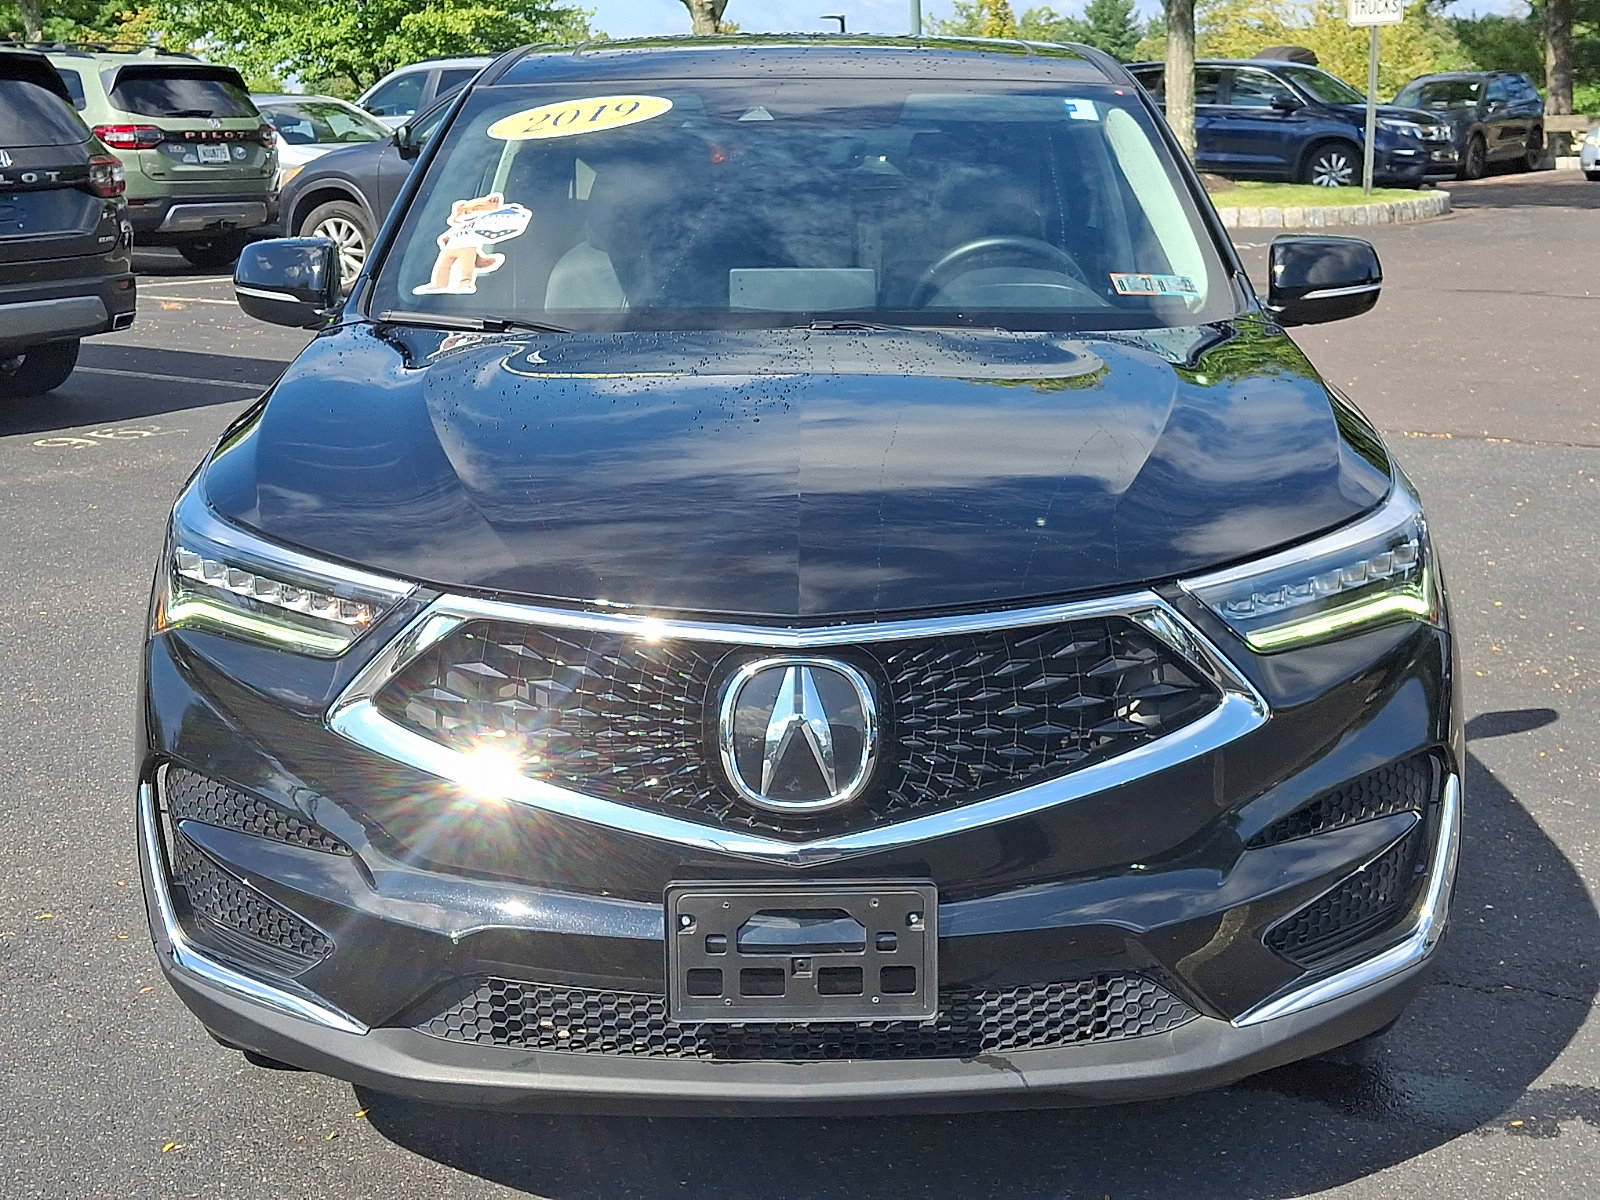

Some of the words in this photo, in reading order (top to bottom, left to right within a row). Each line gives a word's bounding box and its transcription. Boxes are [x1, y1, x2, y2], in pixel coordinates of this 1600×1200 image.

[1354, 0, 1400, 15] TRUCKS
[522, 101, 641, 134] 2019
[184, 131, 246, 140] PILOT
